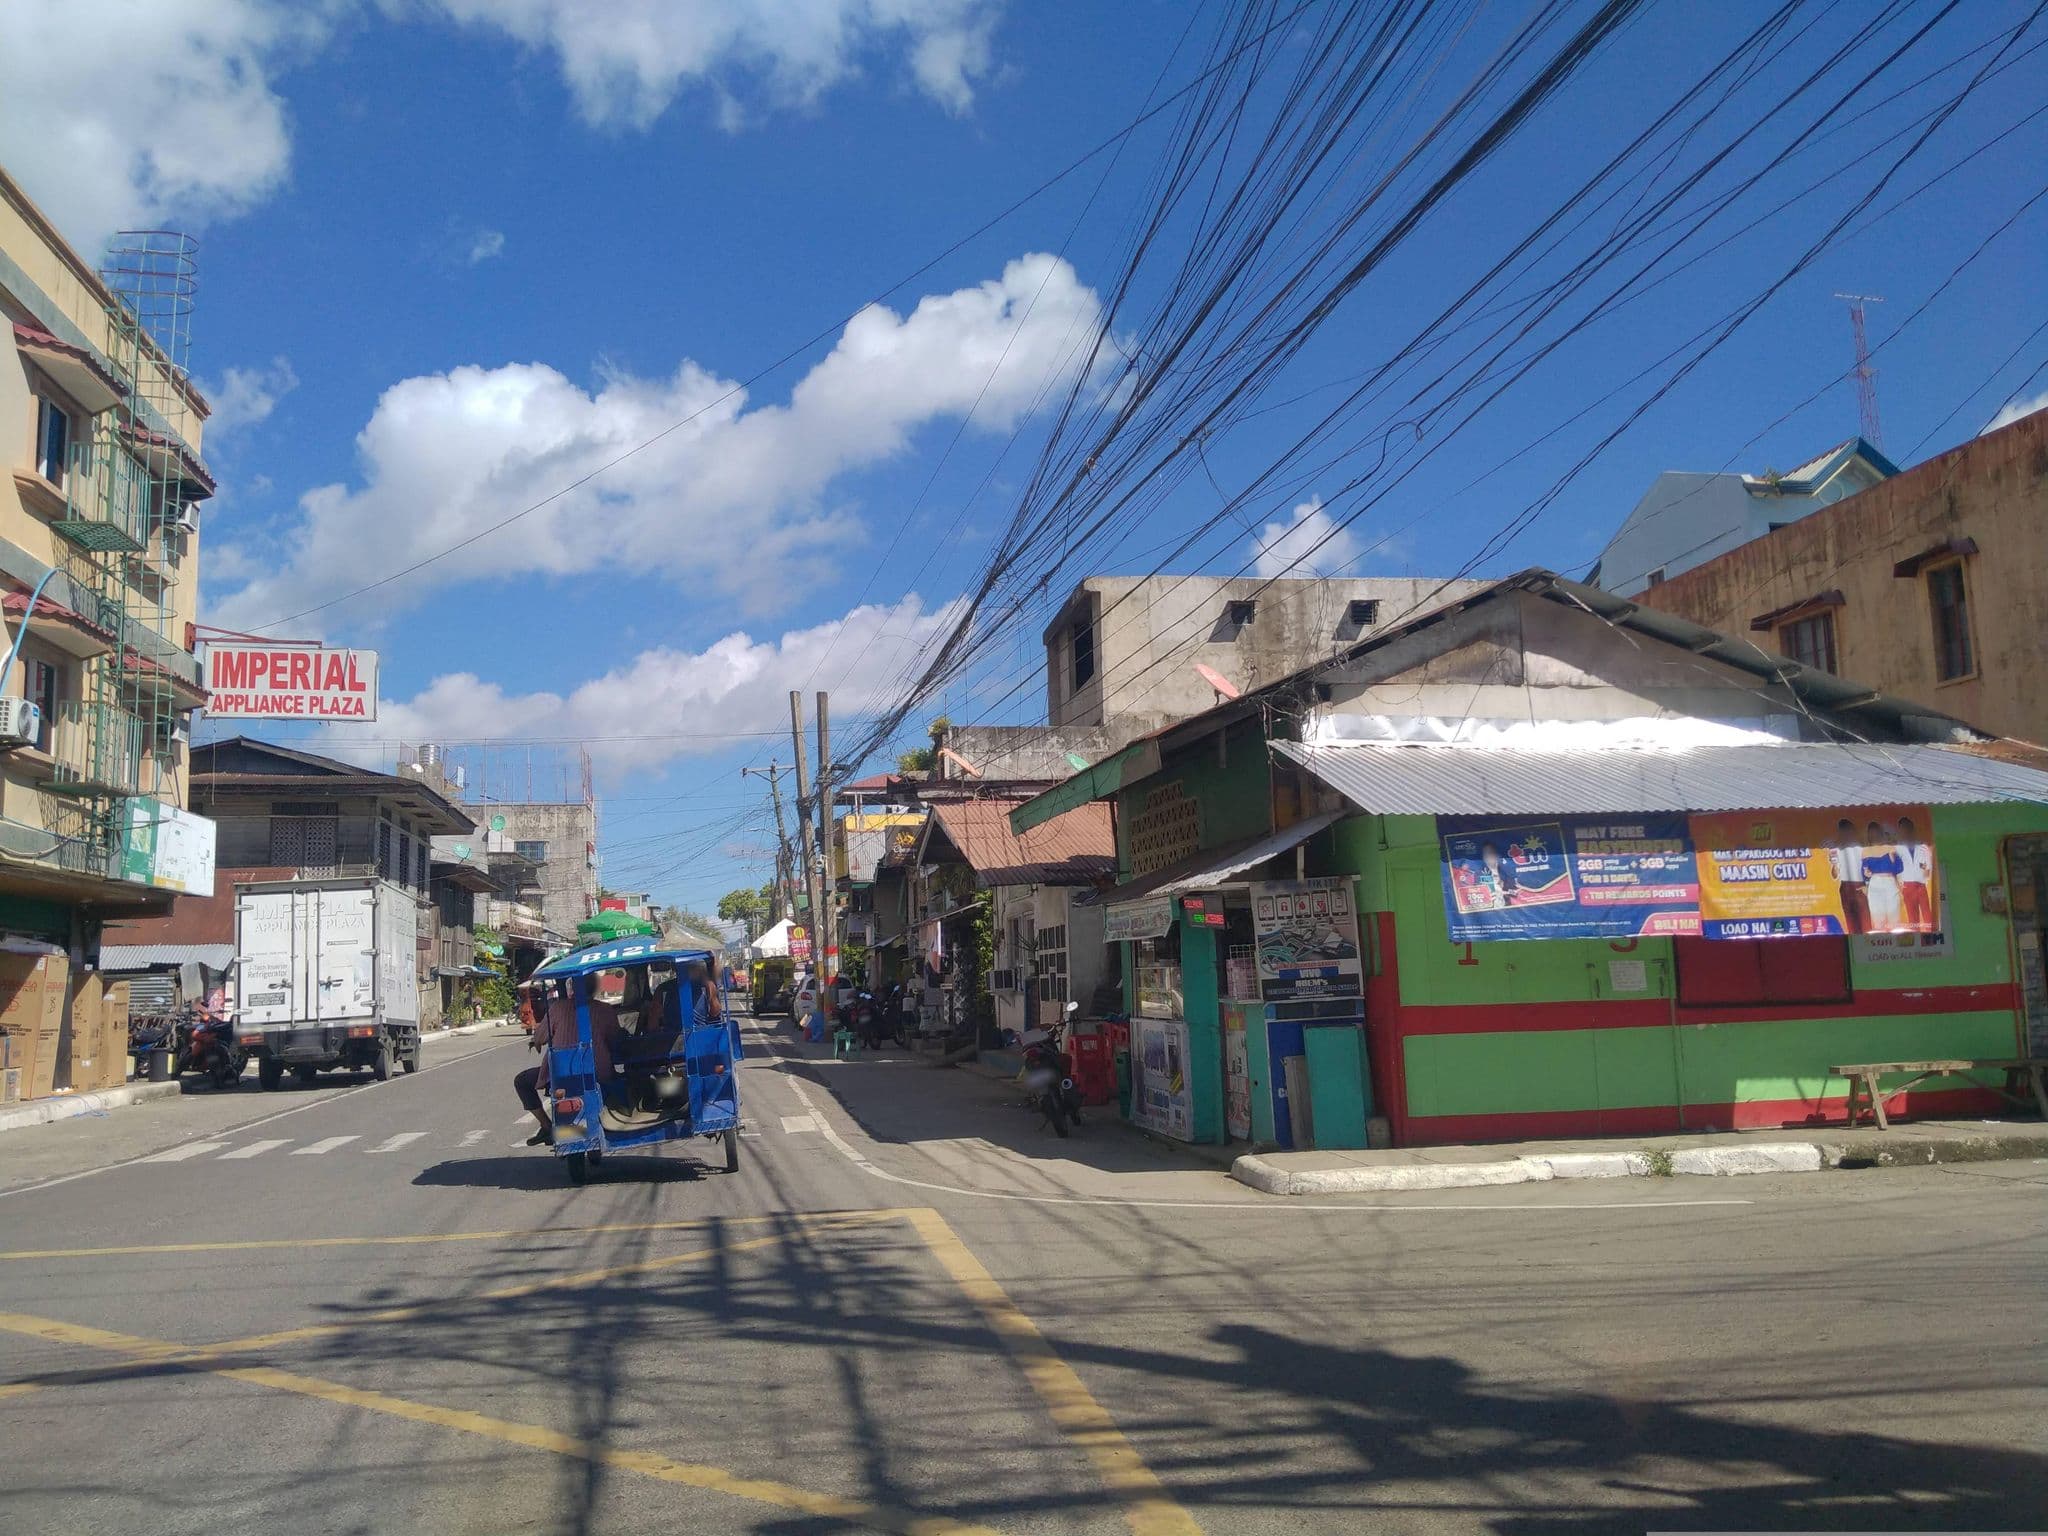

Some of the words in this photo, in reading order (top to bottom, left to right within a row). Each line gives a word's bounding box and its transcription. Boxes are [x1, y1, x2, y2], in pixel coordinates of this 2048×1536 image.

[212, 651, 367, 692] IMPERIAL
[211, 693, 304, 714] APPLIANCE
[309, 695, 366, 716] PLAZA
[1609, 826, 1645, 838] FREE
[1713, 848, 1733, 860] MAS
[1784, 847, 1796, 858] NA
[1799, 847, 1812, 858] SA
[1577, 859, 1603, 870] 2GB
[1639, 857, 1664, 870] 3GB
[1720, 863, 1770, 882] MAASIN
[1773, 862, 1807, 880] CITY!
[1605, 889, 1651, 900] REWARDS
[1652, 888, 1687, 899] POINTS
[253, 897, 364, 921] IMPERIAL
[326, 917, 366, 930] PLAZA
[1721, 922, 1749, 935] LOAD
[1751, 921, 1770, 934] NA!
[247, 969, 287, 979] Refrigerator
